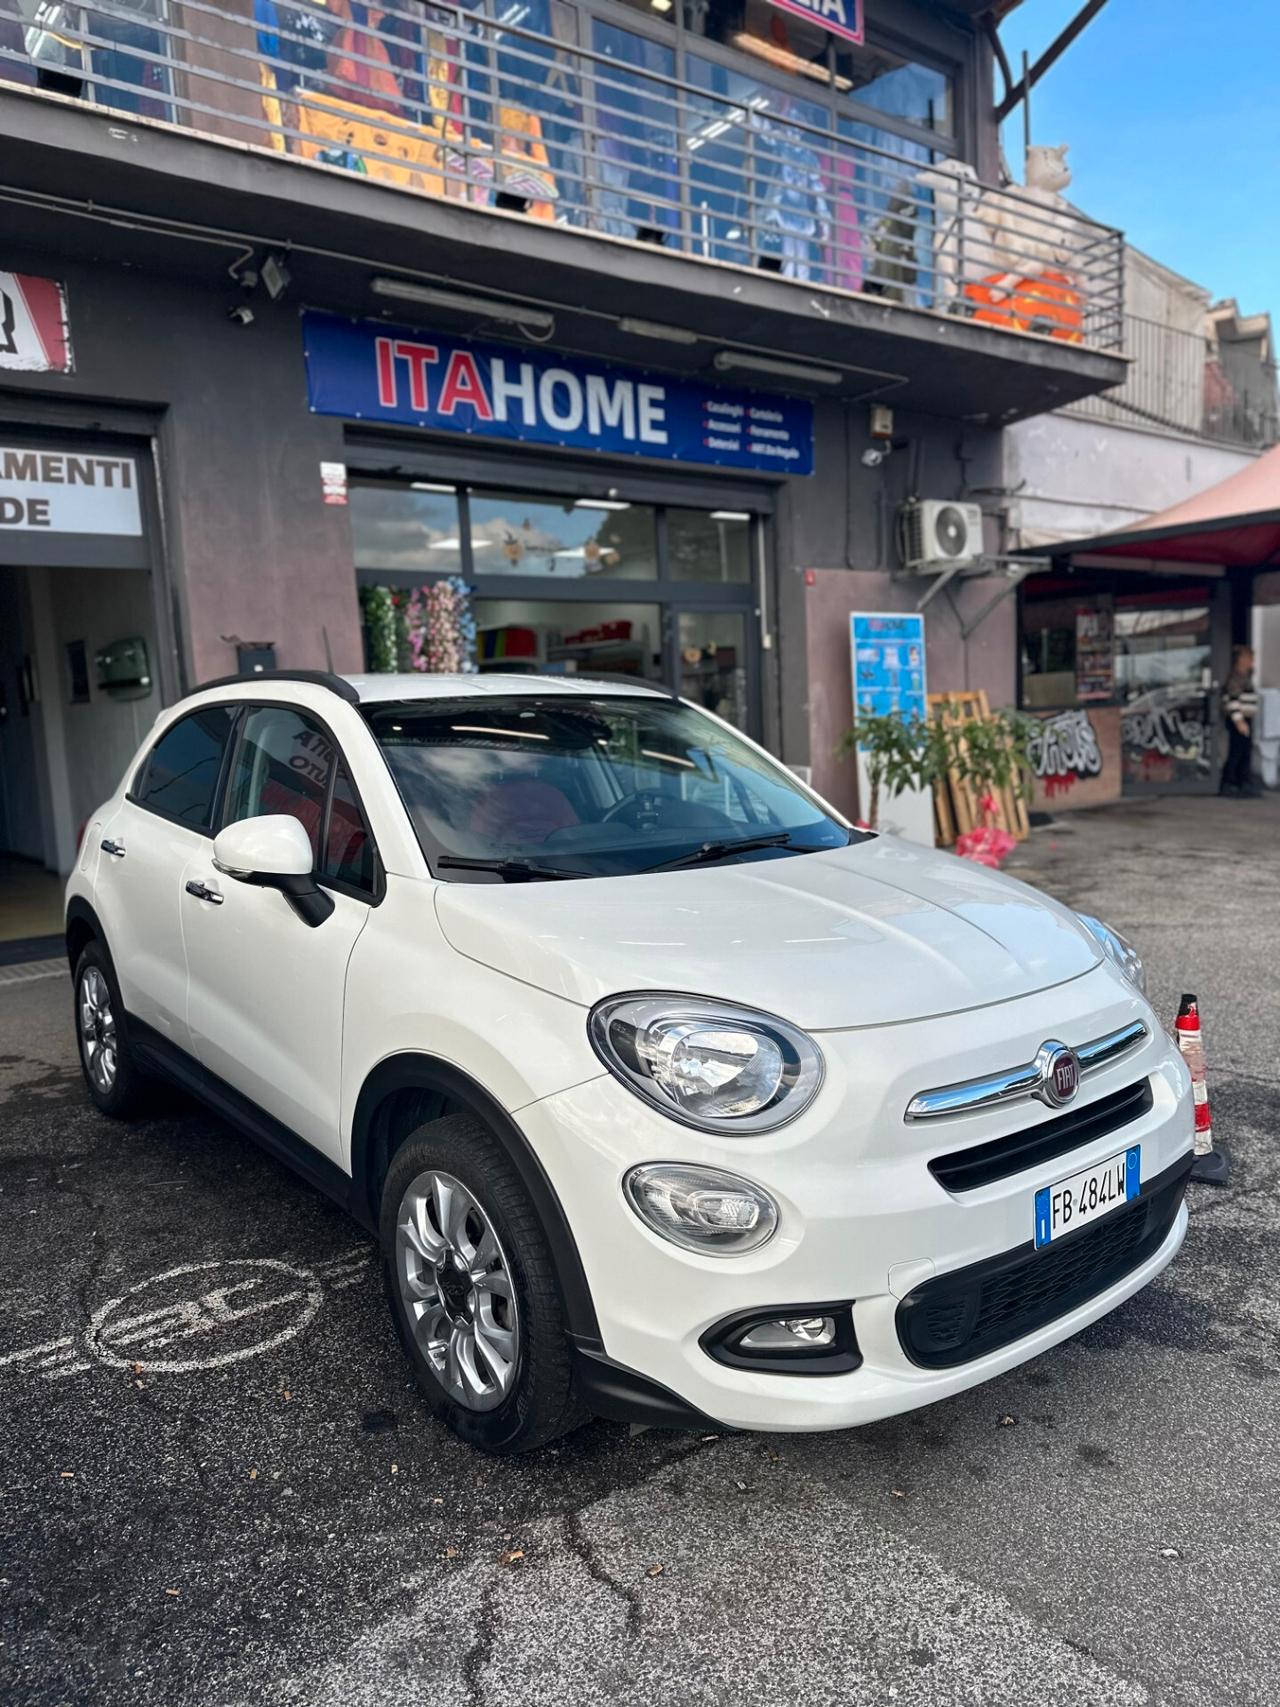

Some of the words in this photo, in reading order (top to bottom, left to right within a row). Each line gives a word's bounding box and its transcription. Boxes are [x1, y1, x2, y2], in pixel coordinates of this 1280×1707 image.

[375, 337, 668, 445] ITAHOME
[0, 451, 131, 489] MENTI
[1056, 1063, 1074, 1091] FIAT
[1052, 1189, 1073, 1230] FB
[1078, 1162, 1126, 1216] 484LW
